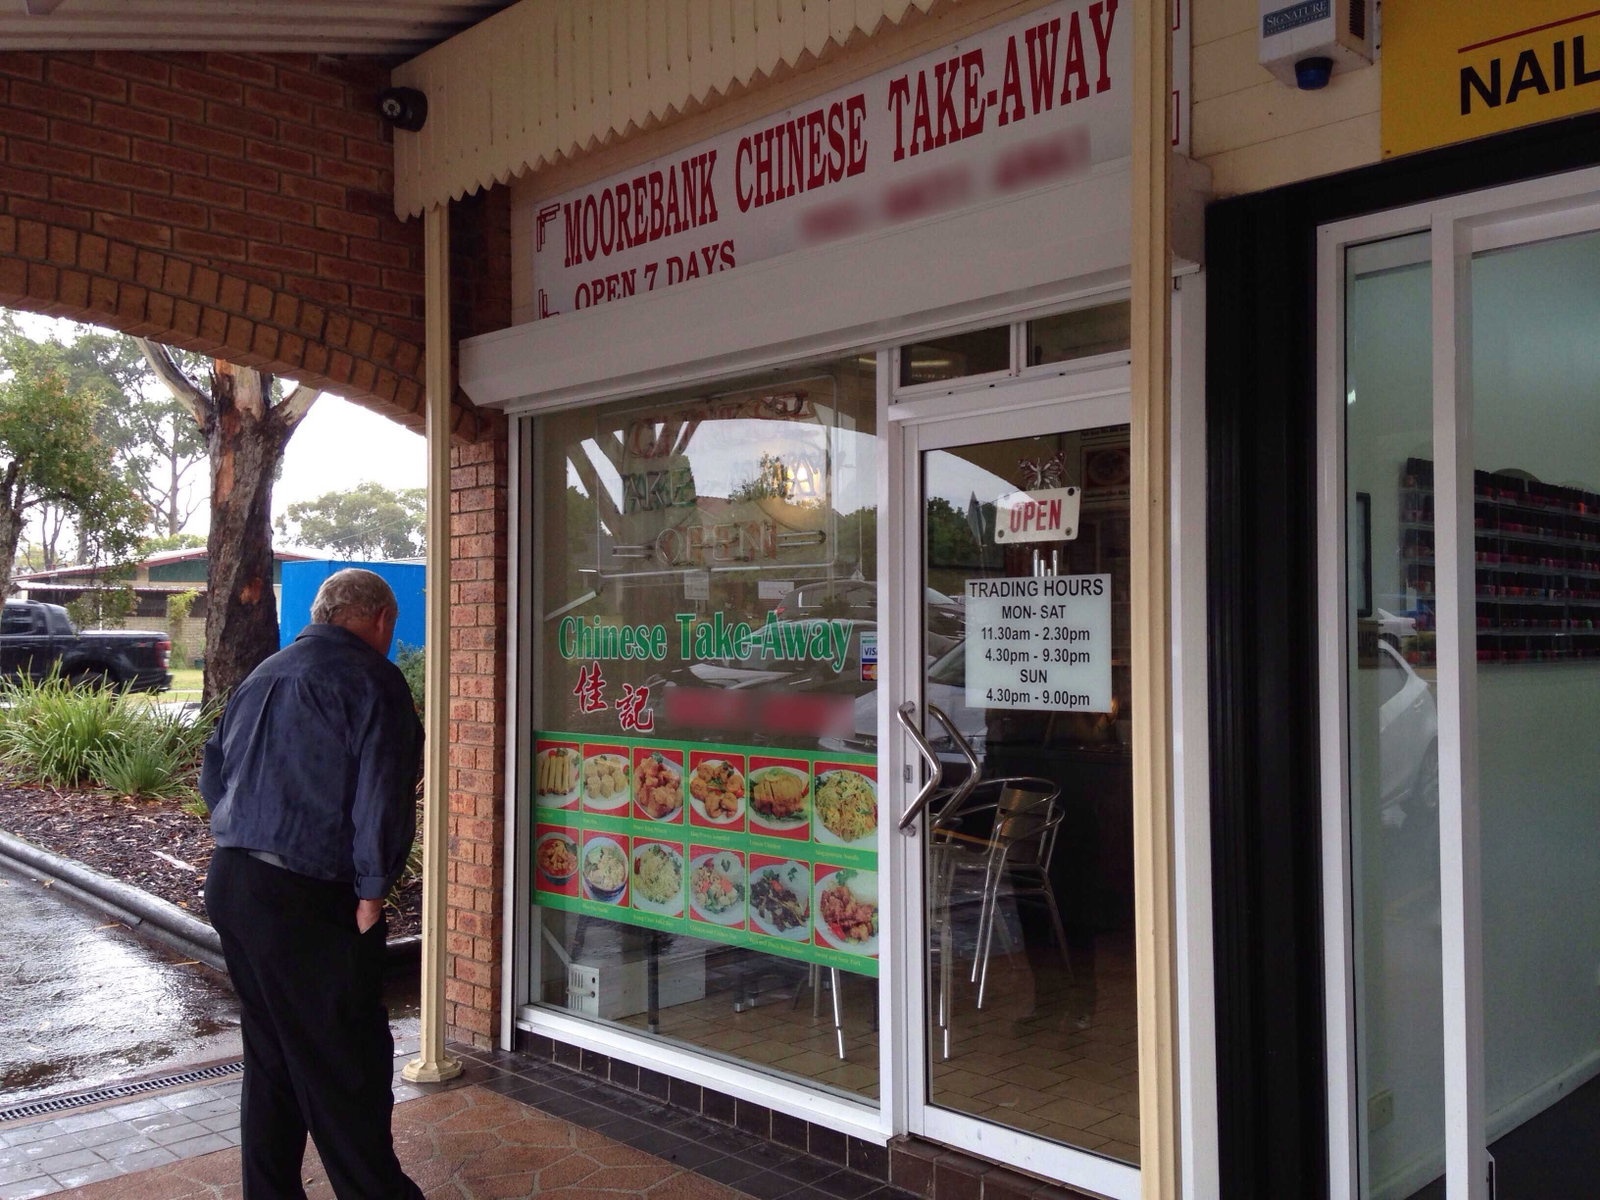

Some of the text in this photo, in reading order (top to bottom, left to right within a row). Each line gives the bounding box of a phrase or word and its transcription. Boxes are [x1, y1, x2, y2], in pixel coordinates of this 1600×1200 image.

[1266, 1, 1328, 26] SIGNATURE
[564, 150, 719, 268] MOOREBANK
[735, 94, 867, 213] CHINESE
[888, 0, 1119, 162] TAKE-AWAY
[575, 239, 736, 310] OPEN 7 DAYS
[1009, 498, 1062, 533] OPEN
[969, 579, 1104, 598] TRADING HOURS
[1040, 605, 1067, 619] SAT
[558, 611, 853, 674] Chinese Take-Away
[981, 626, 1031, 641] 11.30am
[1043, 626, 1091, 642] 2.30pm
[985, 648, 1031, 663] 4.30pm
[1043, 649, 1091, 664] 9.30pm
[1019, 669, 1048, 684] SUN
[572, 660, 655, 734] 佳記
[986, 689, 1031, 705] 4.30pm
[1042, 691, 1091, 707] 9.00pm
